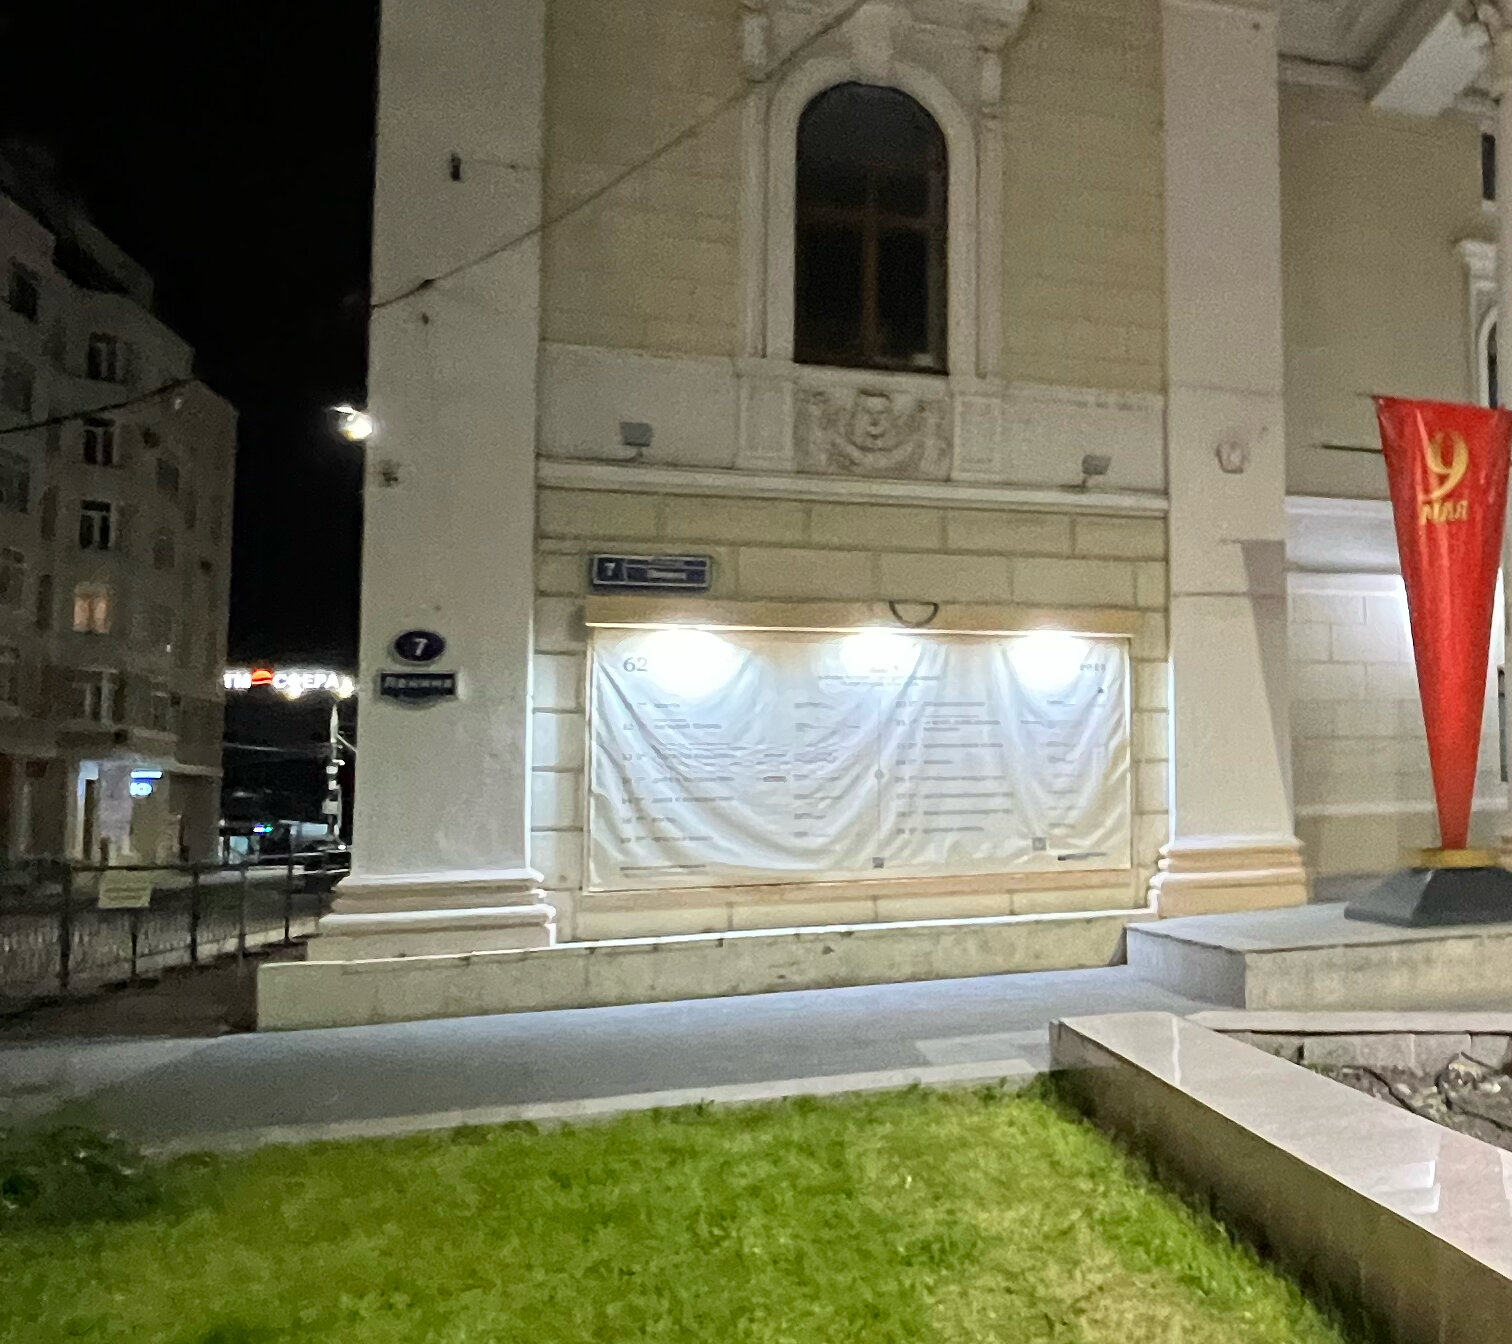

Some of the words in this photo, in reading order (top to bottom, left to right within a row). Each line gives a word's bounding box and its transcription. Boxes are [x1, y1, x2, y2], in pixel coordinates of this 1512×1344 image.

[1427, 429, 1469, 500] 9
[1420, 500, 1468, 526] МАЯ
[604, 562, 616, 576] 7
[413, 638, 428, 656] 7
[623, 657, 648, 672] 62
